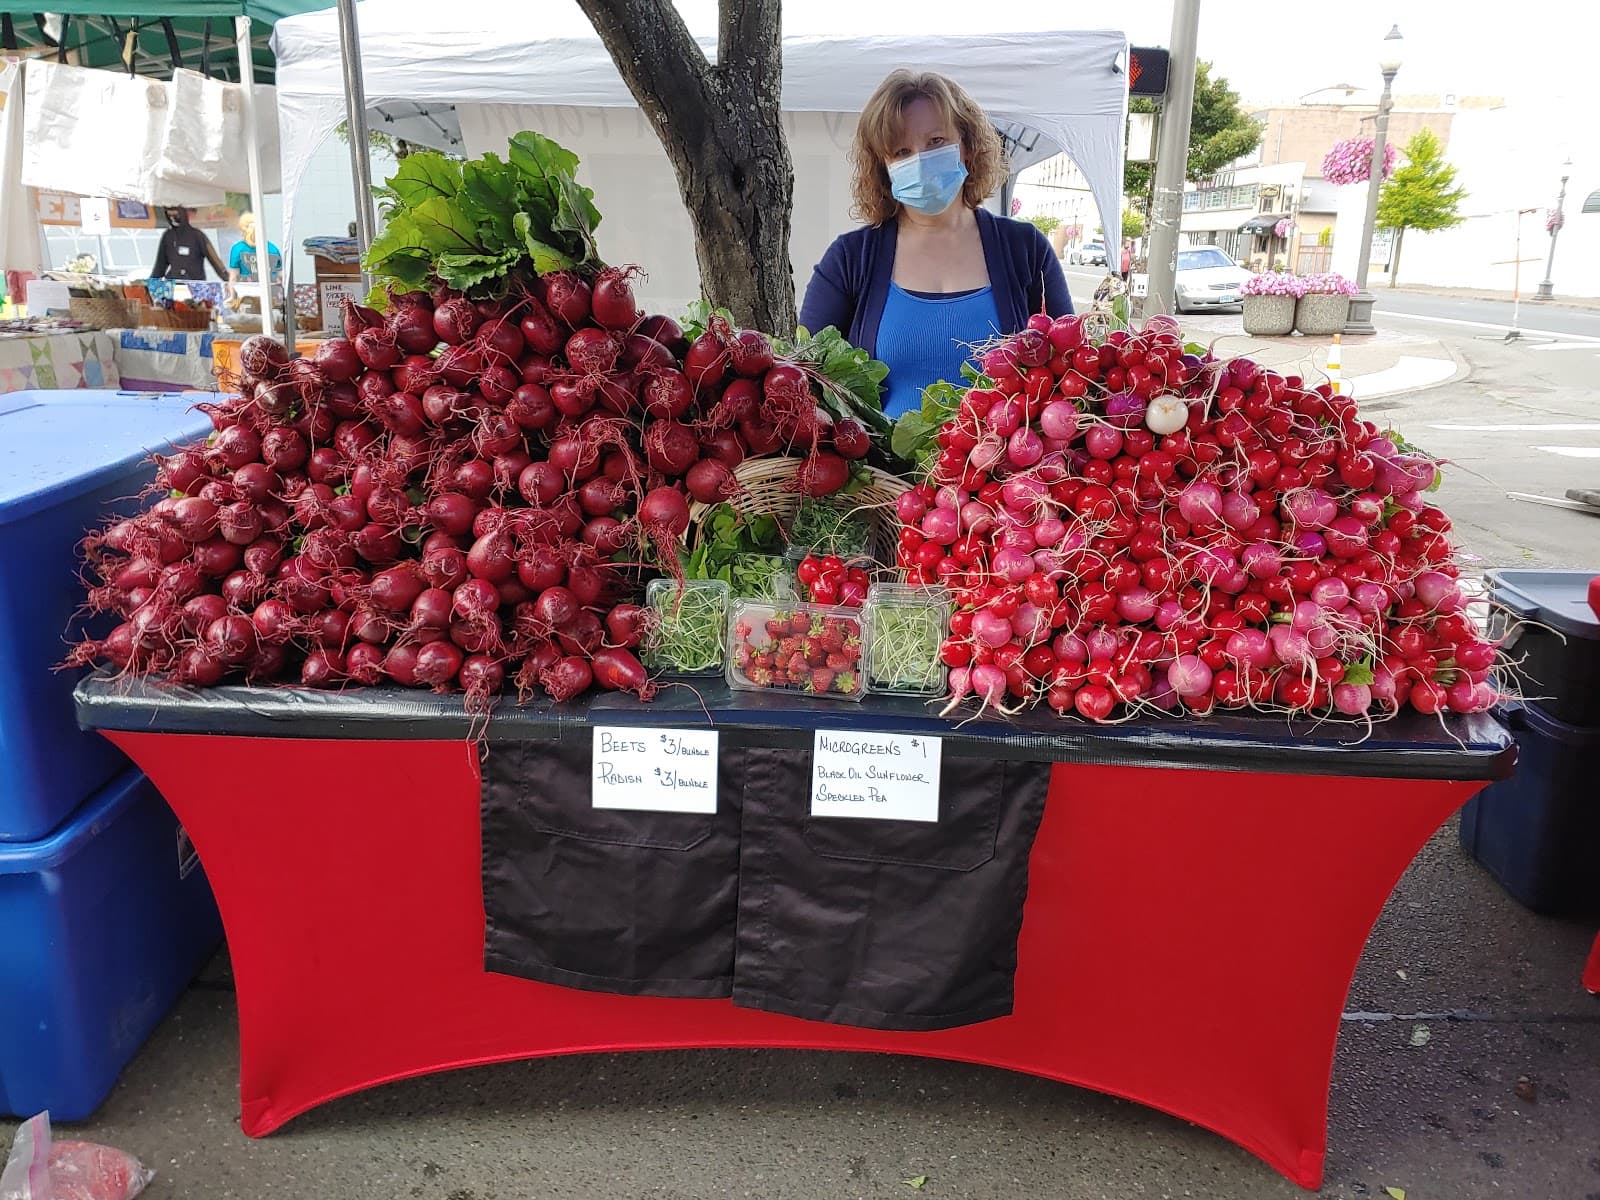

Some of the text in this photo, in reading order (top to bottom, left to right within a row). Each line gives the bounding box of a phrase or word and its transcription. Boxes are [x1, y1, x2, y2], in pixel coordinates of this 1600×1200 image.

[601, 732, 646, 753] BEETS
[910, 738, 927, 759] $1
[597, 762, 642, 785] RADISH
[817, 765, 930, 784] BLACK OIL SUNFLOWER
[816, 783, 887, 803] SPECKLED PEA
